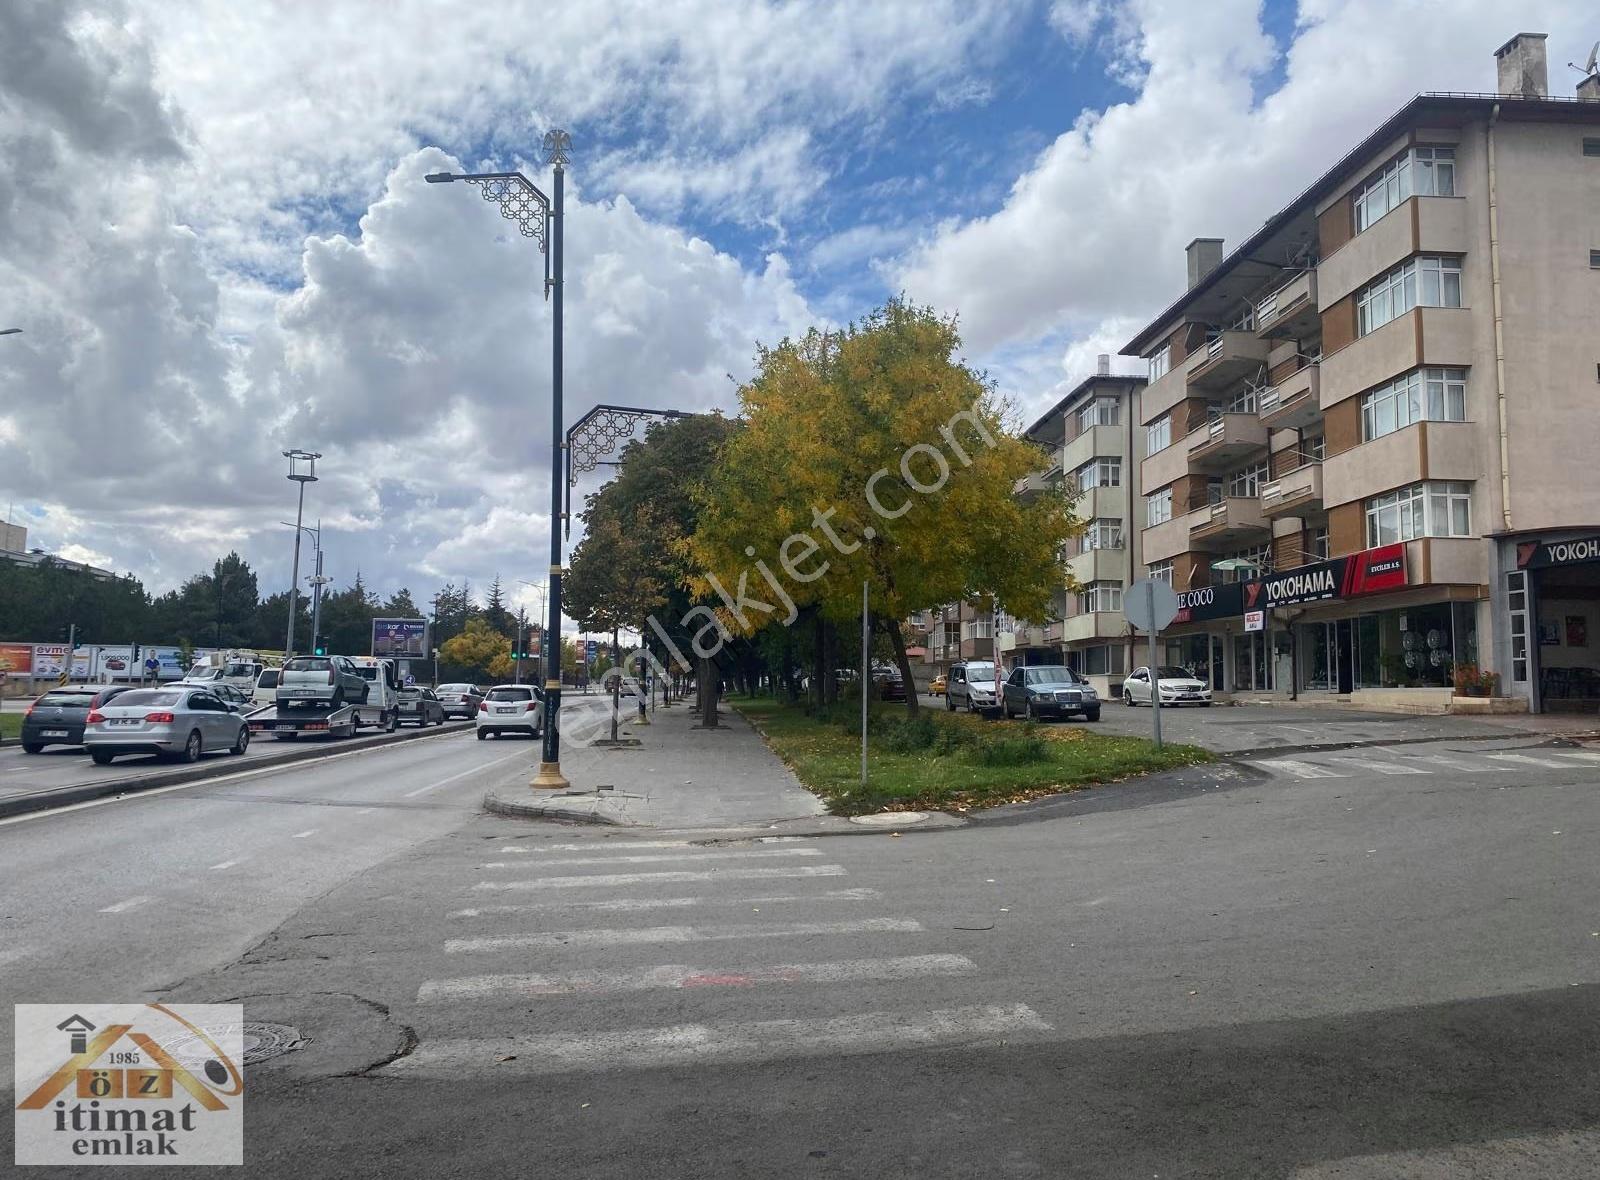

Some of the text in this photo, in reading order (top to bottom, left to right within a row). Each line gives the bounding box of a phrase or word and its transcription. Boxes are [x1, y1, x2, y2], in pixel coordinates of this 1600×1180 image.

[1547, 540, 1600, 562] YOKOH
[1266, 569, 1336, 601] YOKOHAMA
[1187, 588, 1214, 608] COCO
[36, 645, 74, 655] evme
